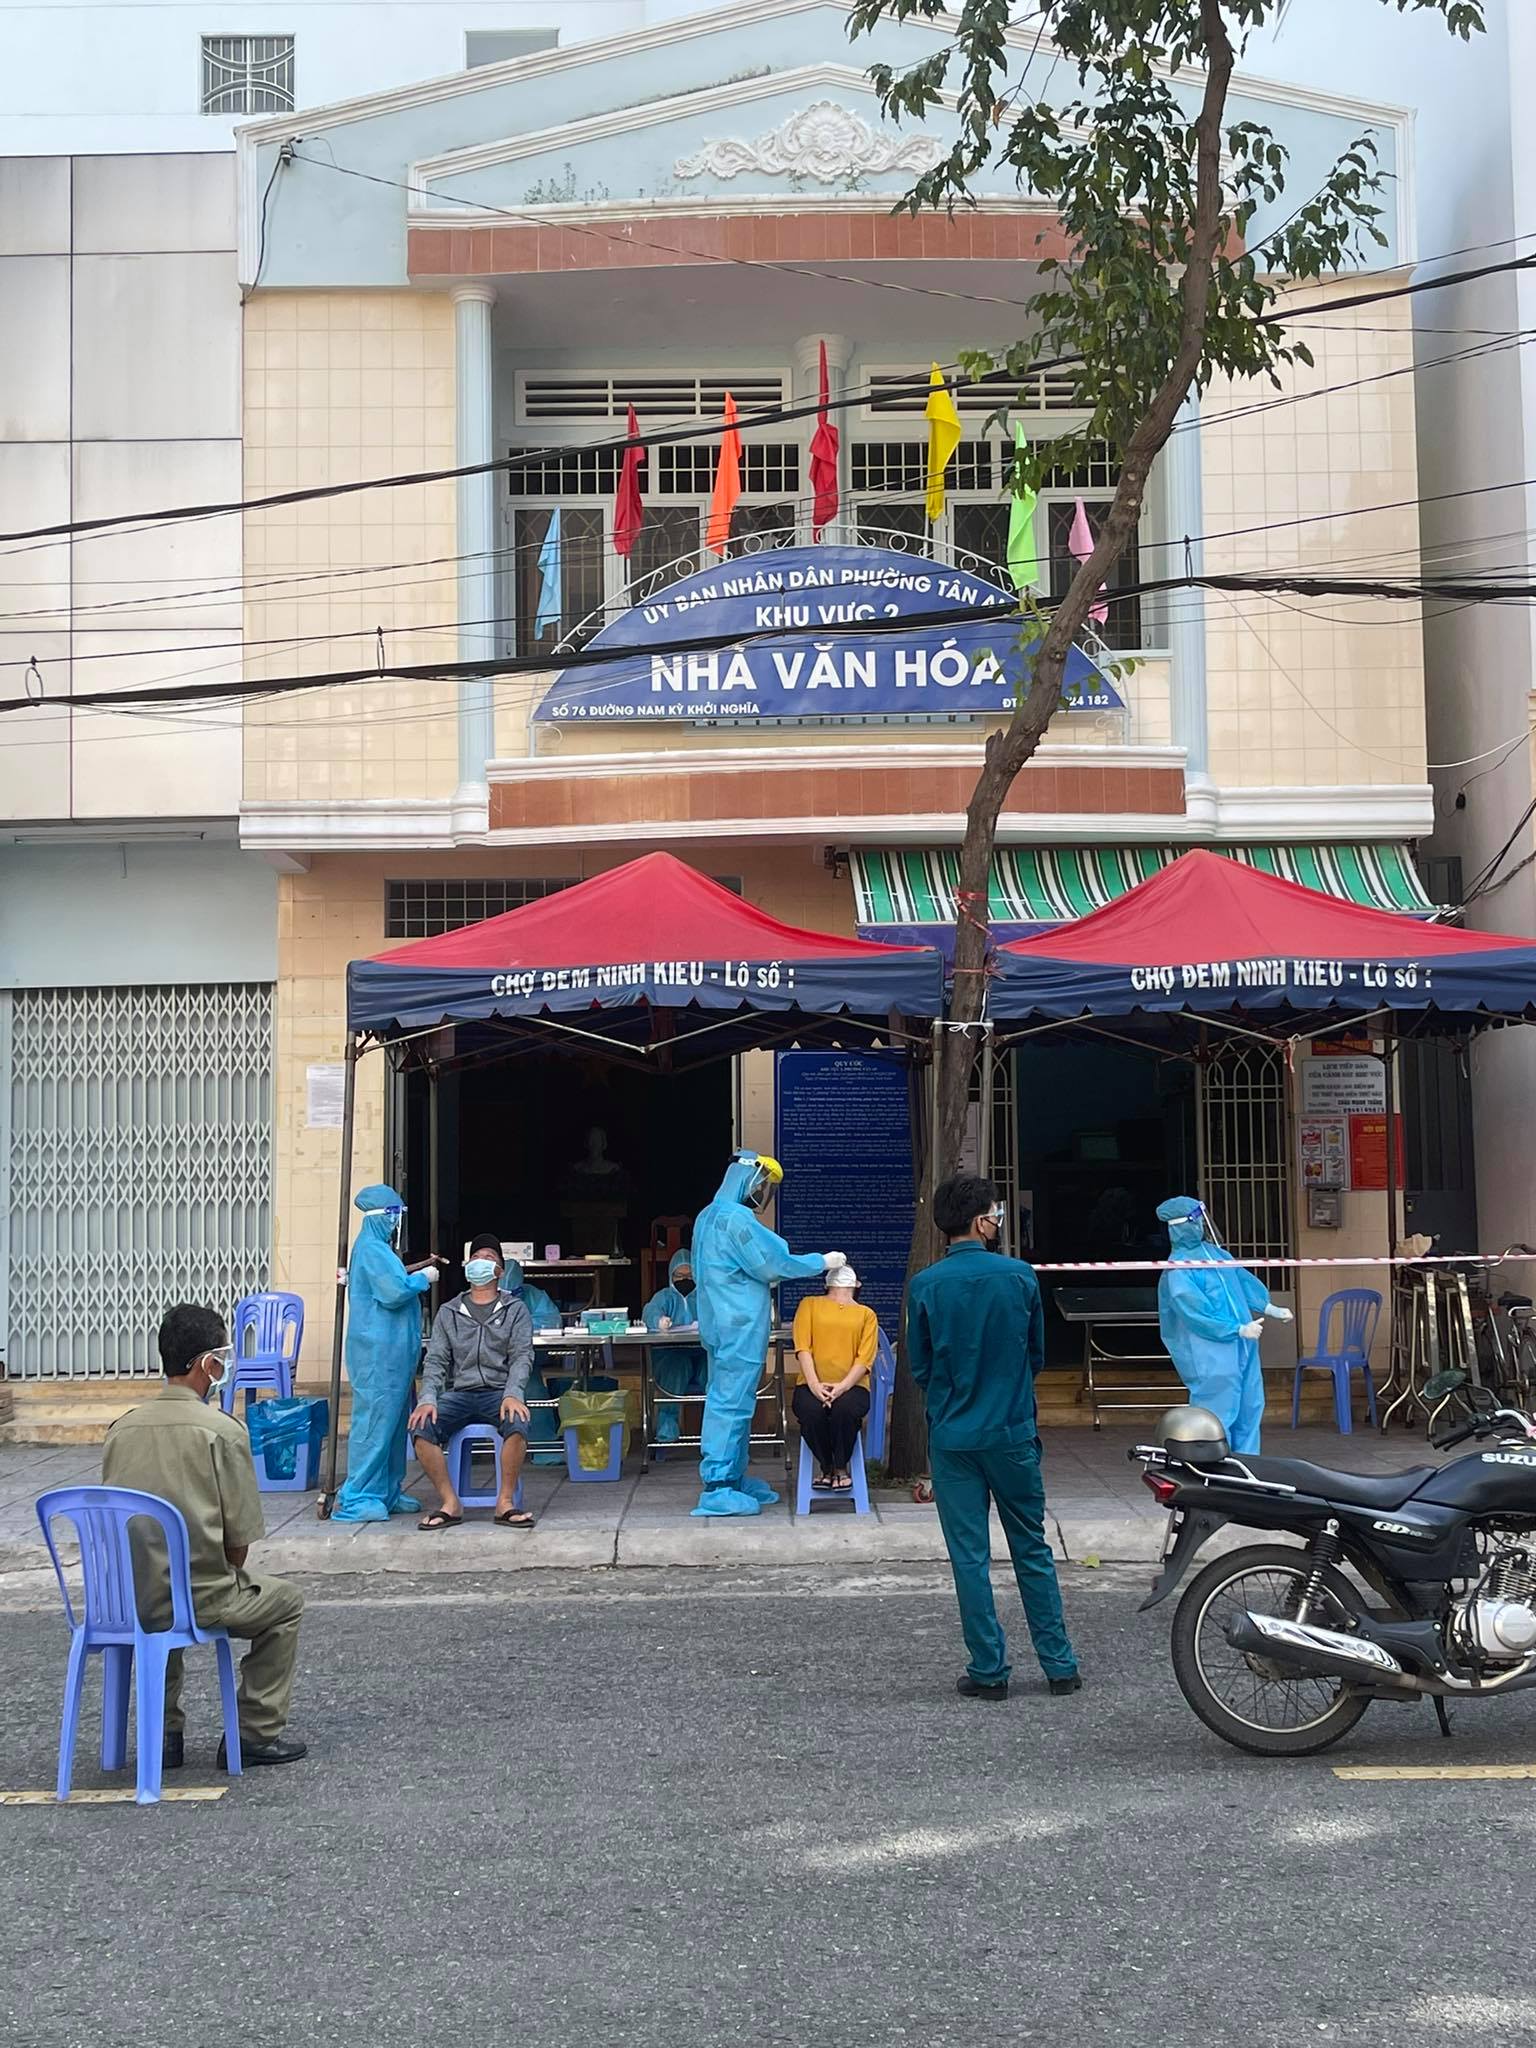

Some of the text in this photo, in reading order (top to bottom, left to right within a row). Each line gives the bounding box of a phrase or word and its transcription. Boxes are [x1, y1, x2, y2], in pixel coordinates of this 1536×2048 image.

[674, 585, 718, 613] BAN
[722, 571, 783, 597] NHÂN
[789, 565, 833, 588] DÂN
[841, 567, 932, 593] PHƯỜNG
[937, 579, 978, 605] TÂN
[755, 606, 810, 627] KHU
[771, 642, 877, 690] VĂN
[895, 637, 1007, 687] HÓA
[552, 703, 569, 717] SỐ
[572, 705, 586, 717] 76
[589, 703, 634, 716] ĐƯỜNG
[638, 704, 664, 716] NAM
[668, 702, 685, 715] KỲ
[688, 701, 717, 715] KHỞI
[720, 701, 760, 714] NGHĨA
[1087, 695, 1109, 706] 182
[490, 970, 536, 998] CHỢ
[597, 962, 646, 987] NINH
[725, 961, 749, 987] Lô
[1130, 965, 1175, 995] CHỢ
[1236, 959, 1286, 987] NINH
[1363, 962, 1387, 988] Lô
